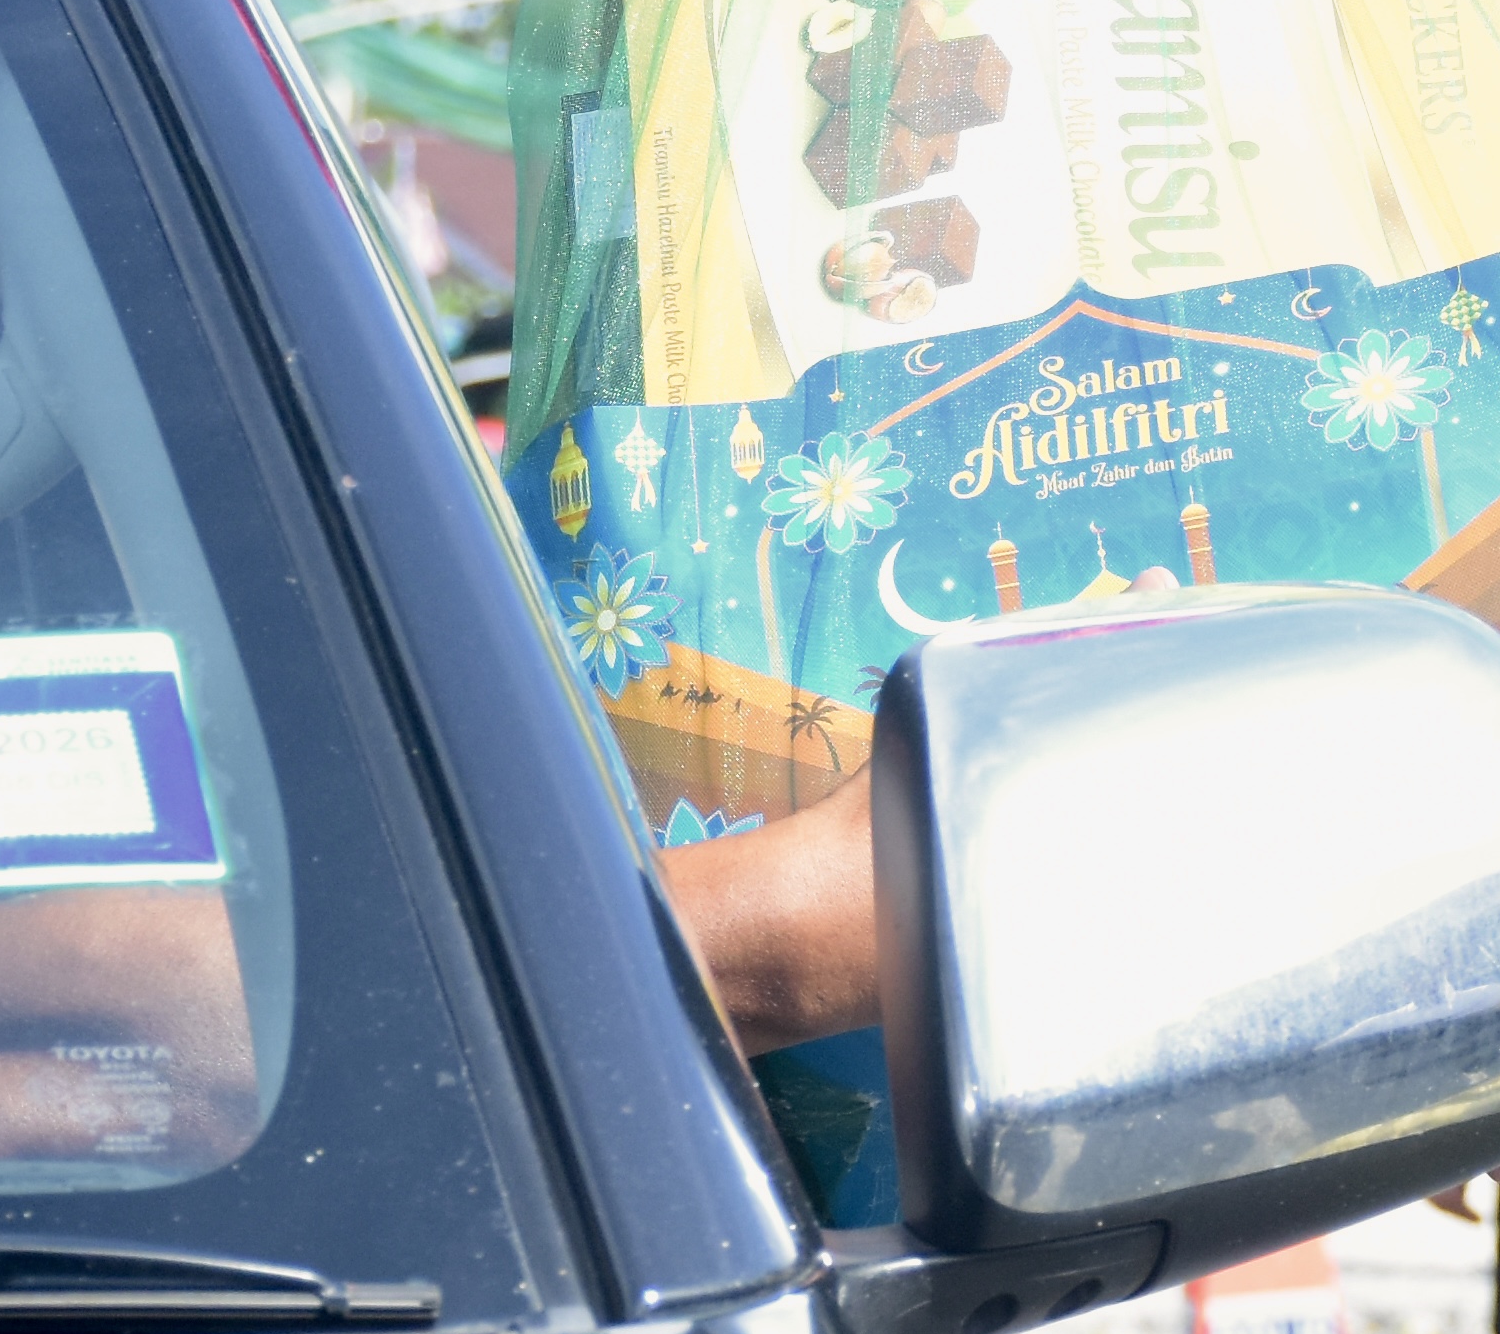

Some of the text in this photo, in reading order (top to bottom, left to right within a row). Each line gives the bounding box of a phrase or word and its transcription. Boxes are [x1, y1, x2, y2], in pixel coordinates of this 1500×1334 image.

[1058, 26, 1086, 87] Paste
[1066, 97, 1096, 150] Milk
[653, 126, 673, 201] Tiramisu
[657, 204, 680, 279] Hazelnut
[661, 282, 681, 325] Paste
[664, 329, 684, 369] Milk
[1028, 356, 1183, 416] Salam
[949, 389, 1231, 499] Aidilfitri
[1035, 444, 1233, 499] Maaf Zahir dan Batin
[51, 1045, 174, 1061] TOYOTA
